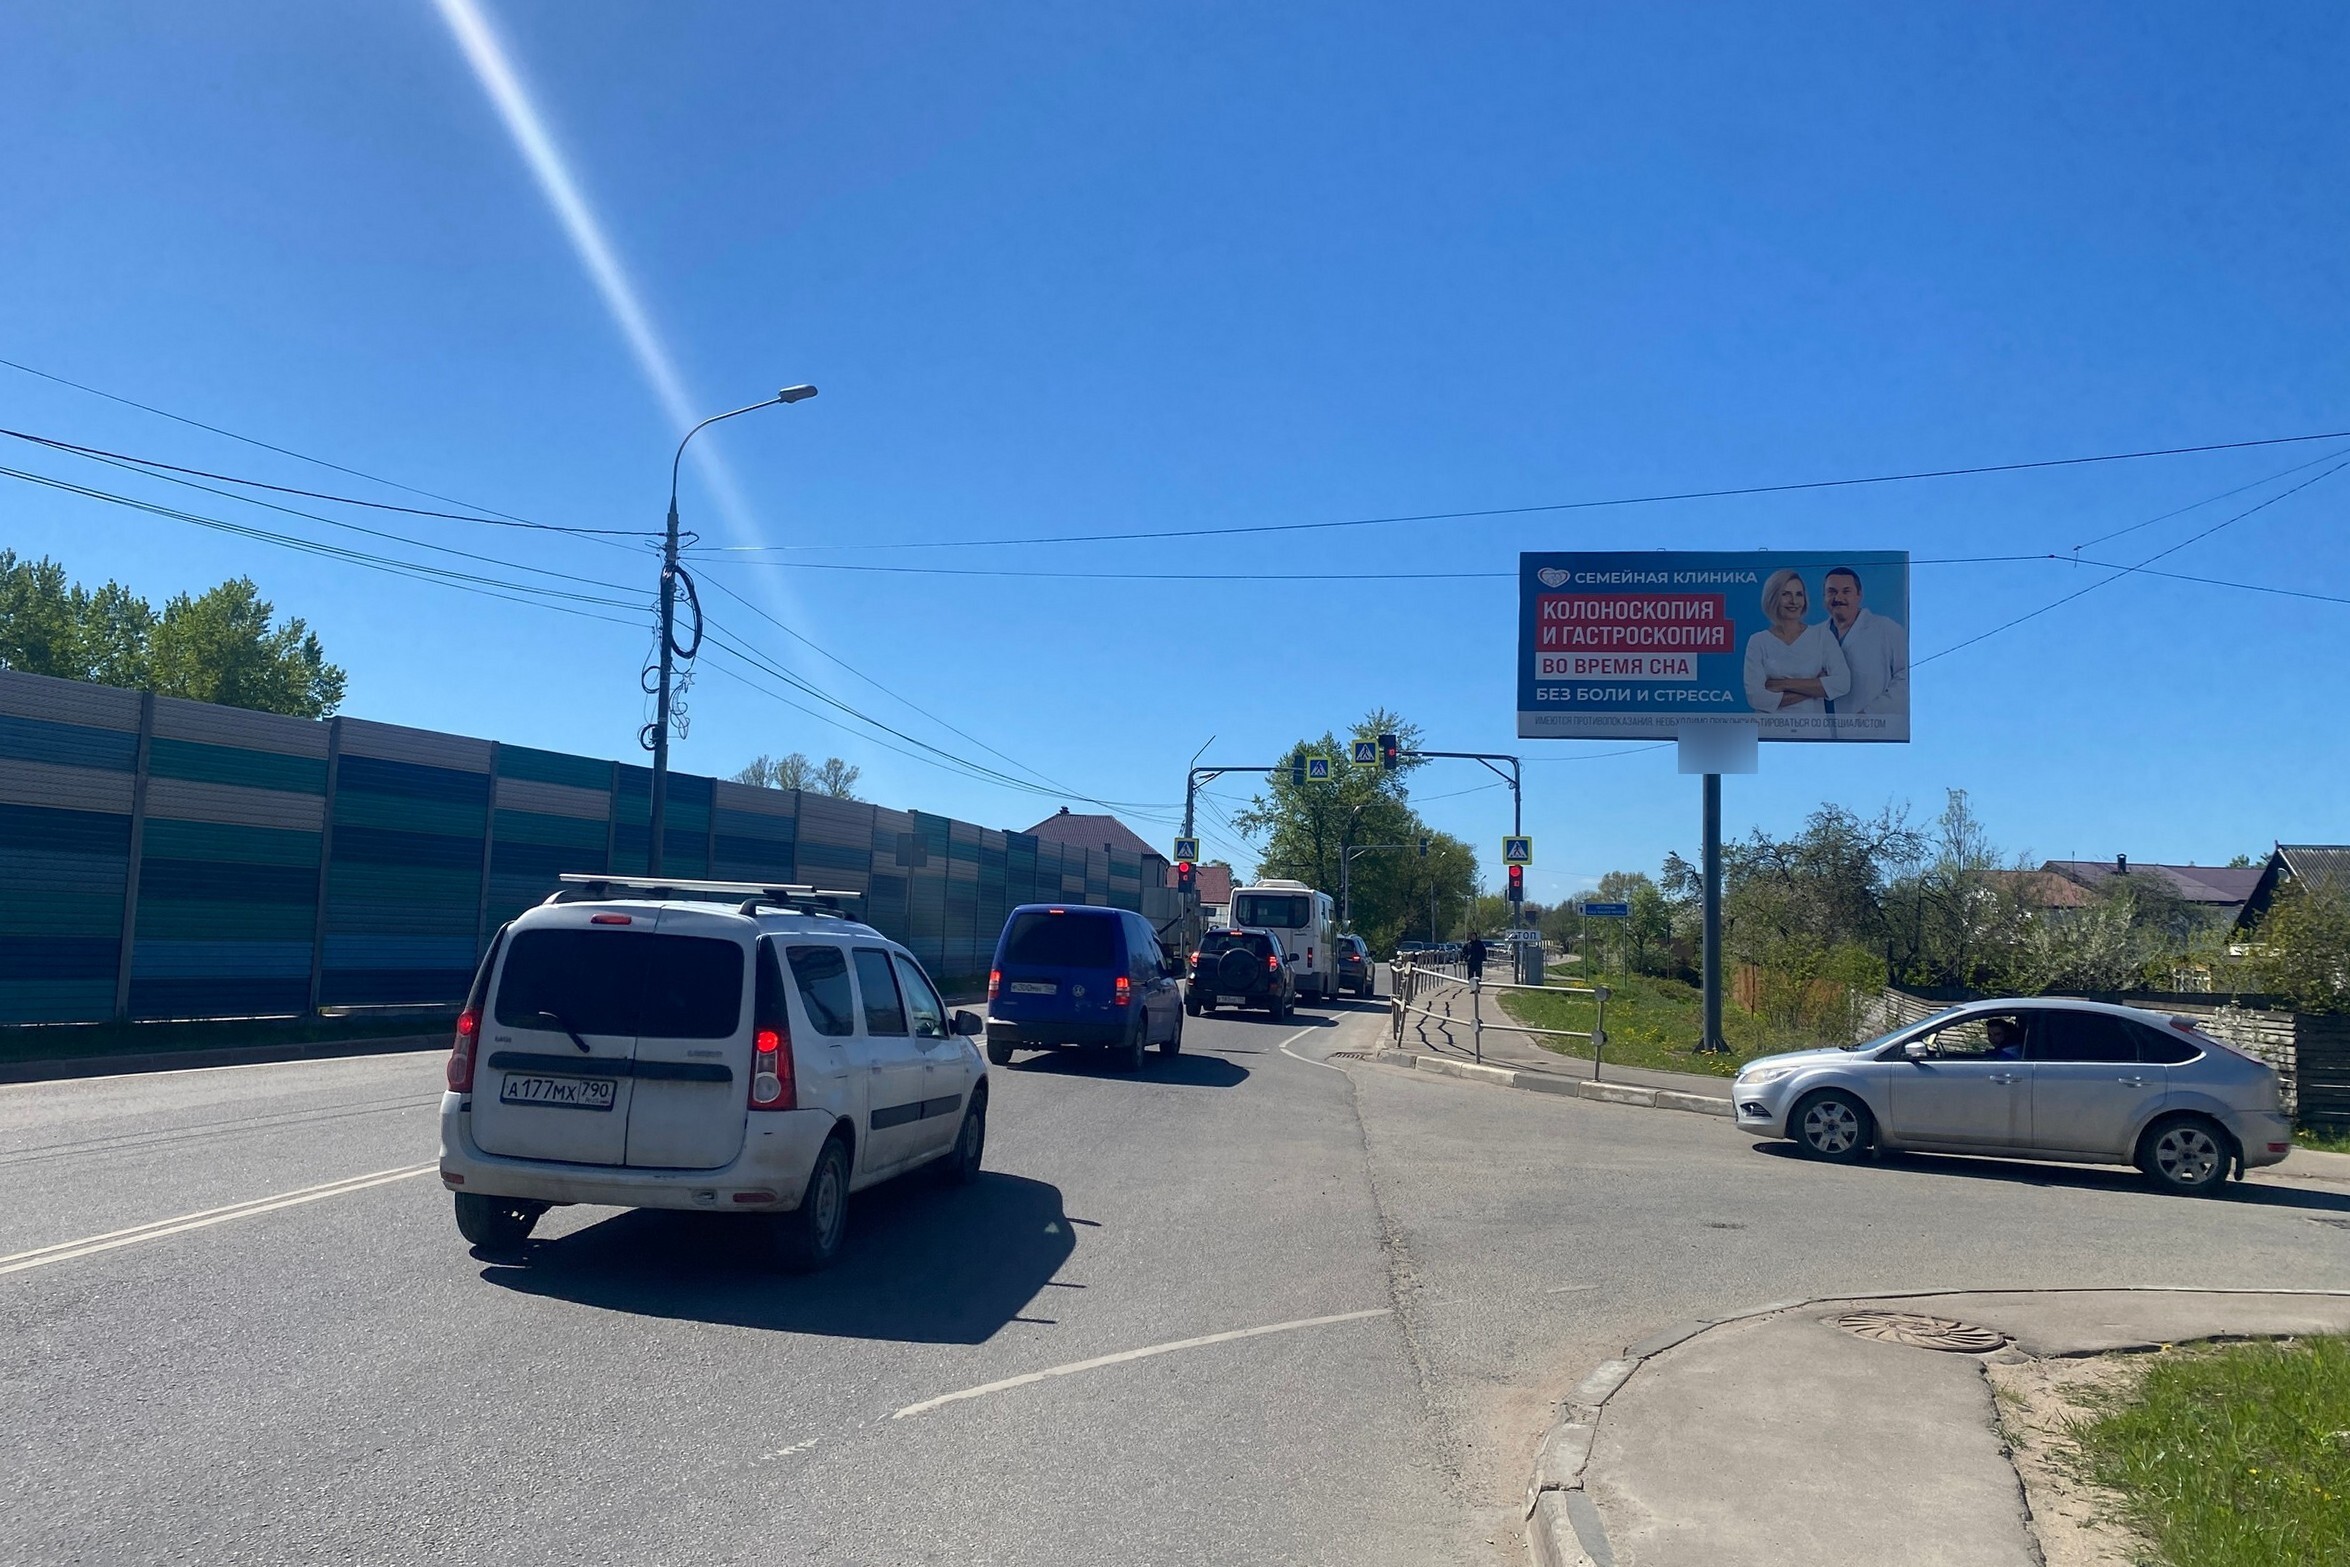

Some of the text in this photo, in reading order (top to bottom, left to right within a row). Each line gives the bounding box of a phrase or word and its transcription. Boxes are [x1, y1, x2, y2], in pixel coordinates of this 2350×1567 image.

[1575, 570, 1758, 584] СЕМЕЙНАЯ КЛИНИКА
[1543, 600, 1714, 620] КОЛОНОСКОПИЯ
[1543, 626, 1725, 645] И ГАСТРОСКОПИЯ
[1542, 658, 1690, 675] ВО ВРЕМЯ СНА
[1536, 687, 1734, 702] БЕЗ БОЛИ И СТРЕССА
[1535, 715, 1573, 726] ИМЕЮТСЯ
[1811, 718, 1821, 728] СО
[1823, 718, 1886, 729] СПЕЦИАЛИСТОМ
[582, 1082, 609, 1098] 790
